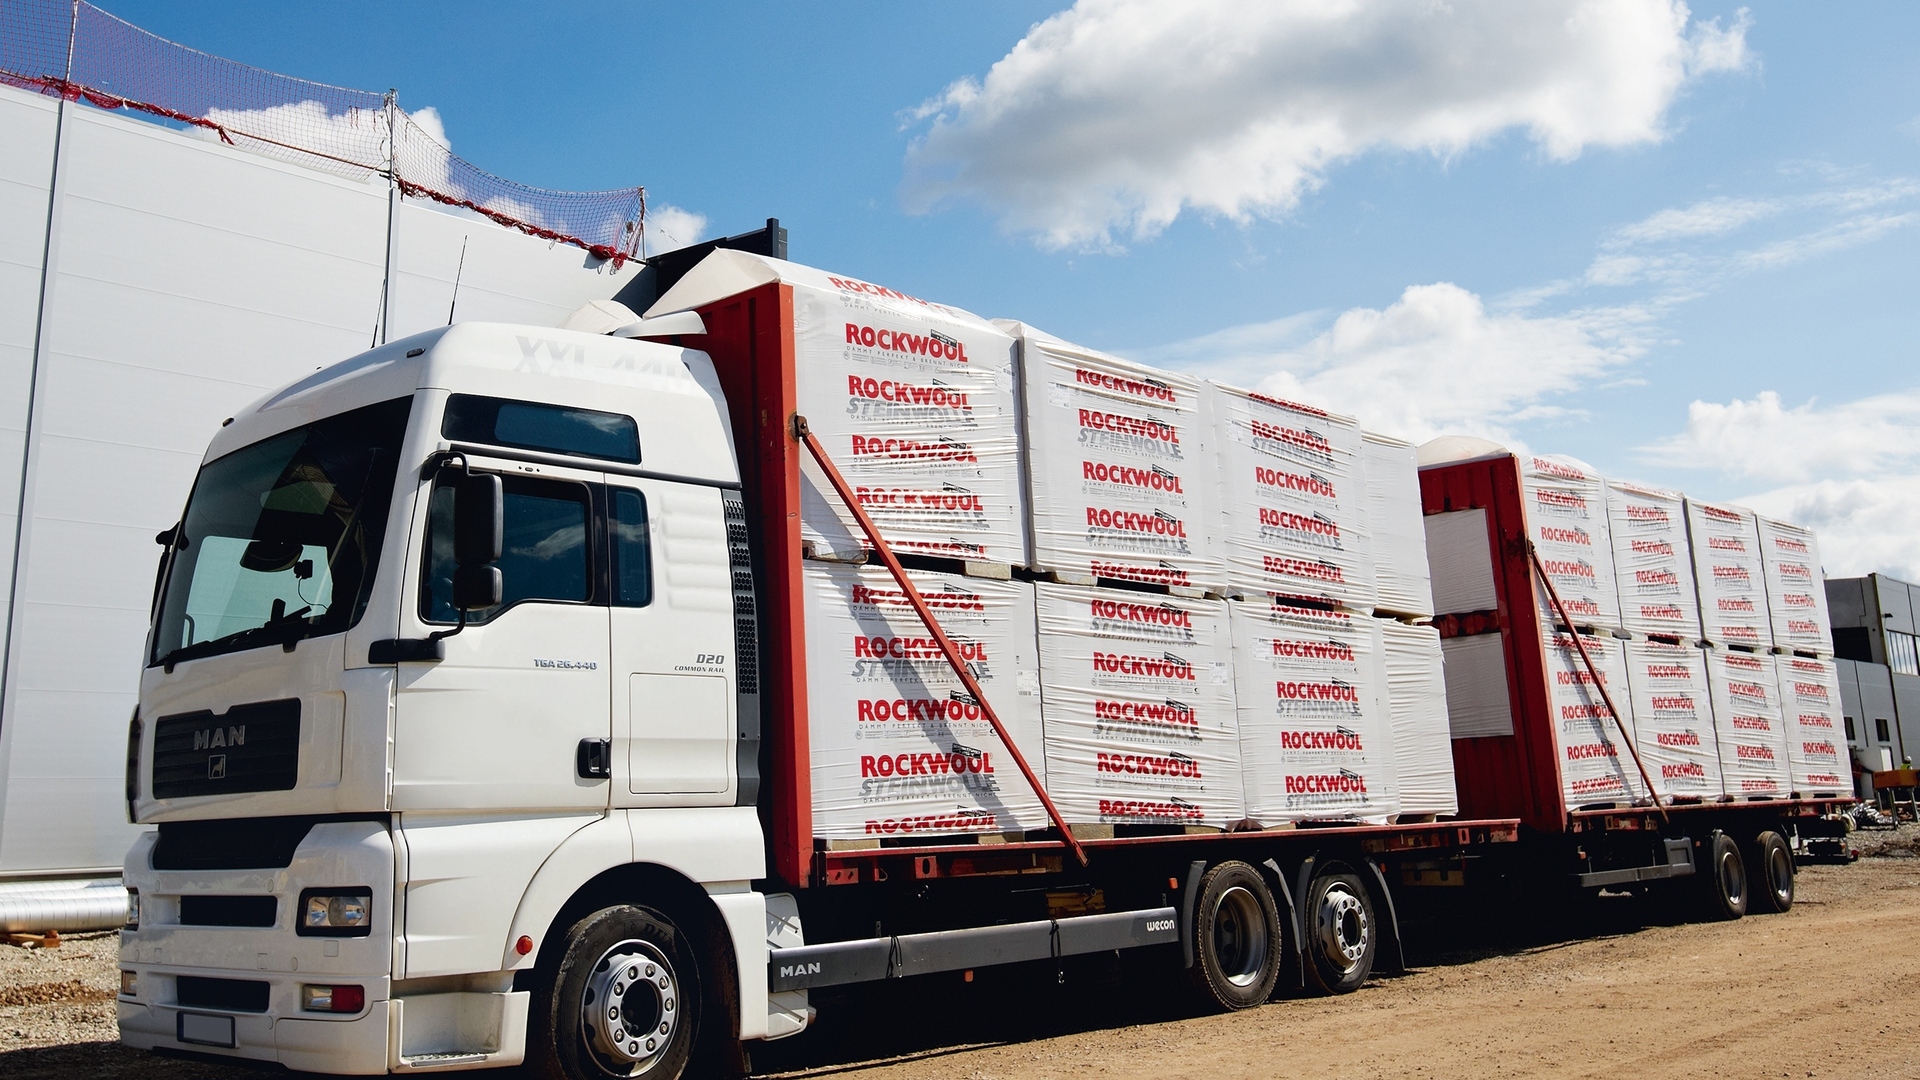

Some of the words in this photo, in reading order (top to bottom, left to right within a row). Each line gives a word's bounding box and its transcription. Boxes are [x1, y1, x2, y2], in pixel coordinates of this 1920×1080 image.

[845, 323, 968, 363] ROCKWOOL
[877, 350, 908, 360] PERFEKT
[920, 358, 946, 366] BRENNT
[848, 375, 973, 410] ROCKWOOL
[1076, 369, 1176, 402] ROCKWOOL
[1079, 408, 1180, 444] ROCKWOOL
[1077, 427, 1184, 460] STEINWOLLE
[1252, 420, 1332, 454] ROCKWOOL
[852, 434, 977, 463] ROCKWOOL
[1083, 461, 1183, 494] ROCKWOOL
[1256, 466, 1336, 498] ROCKWOOL
[1537, 489, 1587, 509] ROCKWOOL
[1087, 507, 1187, 539] ROCKWOOL
[1260, 507, 1340, 537] ROCKWOOL
[1541, 526, 1591, 545] ROCKWOOL
[1631, 540, 1675, 556] ROCKWOOL
[1264, 555, 1345, 583] ROCKWOOL
[1545, 560, 1595, 578] ROCKWOOL
[1636, 570, 1679, 585] ROCKWOOL
[1091, 599, 1192, 628] ROCKWOOL
[1641, 606, 1683, 619] ROCKWOOL
[1718, 599, 1754, 612] ROCKWOOL
[696, 654, 725, 665] D20
[1273, 639, 1355, 661] ROCKWOOL
[533, 658, 556, 668] TGA
[557, 660, 598, 670] 26.440
[1094, 652, 1195, 681] ROCKWOOL
[1276, 681, 1359, 702] ROCKWOOL
[1095, 699, 1198, 726] ROCKWOOL
[1652, 697, 1695, 710] ROCKWOOL
[1733, 717, 1771, 731] ROCKWOOL
[1799, 715, 1833, 728] ROCKWOOL
[193, 724, 246, 751] MAN
[1281, 731, 1363, 750] ROCKWOOL
[1657, 733, 1700, 748] ROCKWOOL
[1567, 744, 1618, 760] ROCKWOOL
[1737, 745, 1774, 759] ROCKWOOL
[1803, 742, 1837, 755] ROCKWOOL
[861, 752, 995, 778] ROCKWOOL
[1097, 752, 1203, 779] ROCKWOOL
[1662, 764, 1705, 779] ROCKWOOL
[858, 774, 1000, 797] STEINWOLLE
[1285, 775, 1367, 793] ROCKWOOL
[865, 813, 998, 835] ROCKWOOL
[1146, 919, 1175, 931] wecon
[780, 962, 821, 978] MAN
